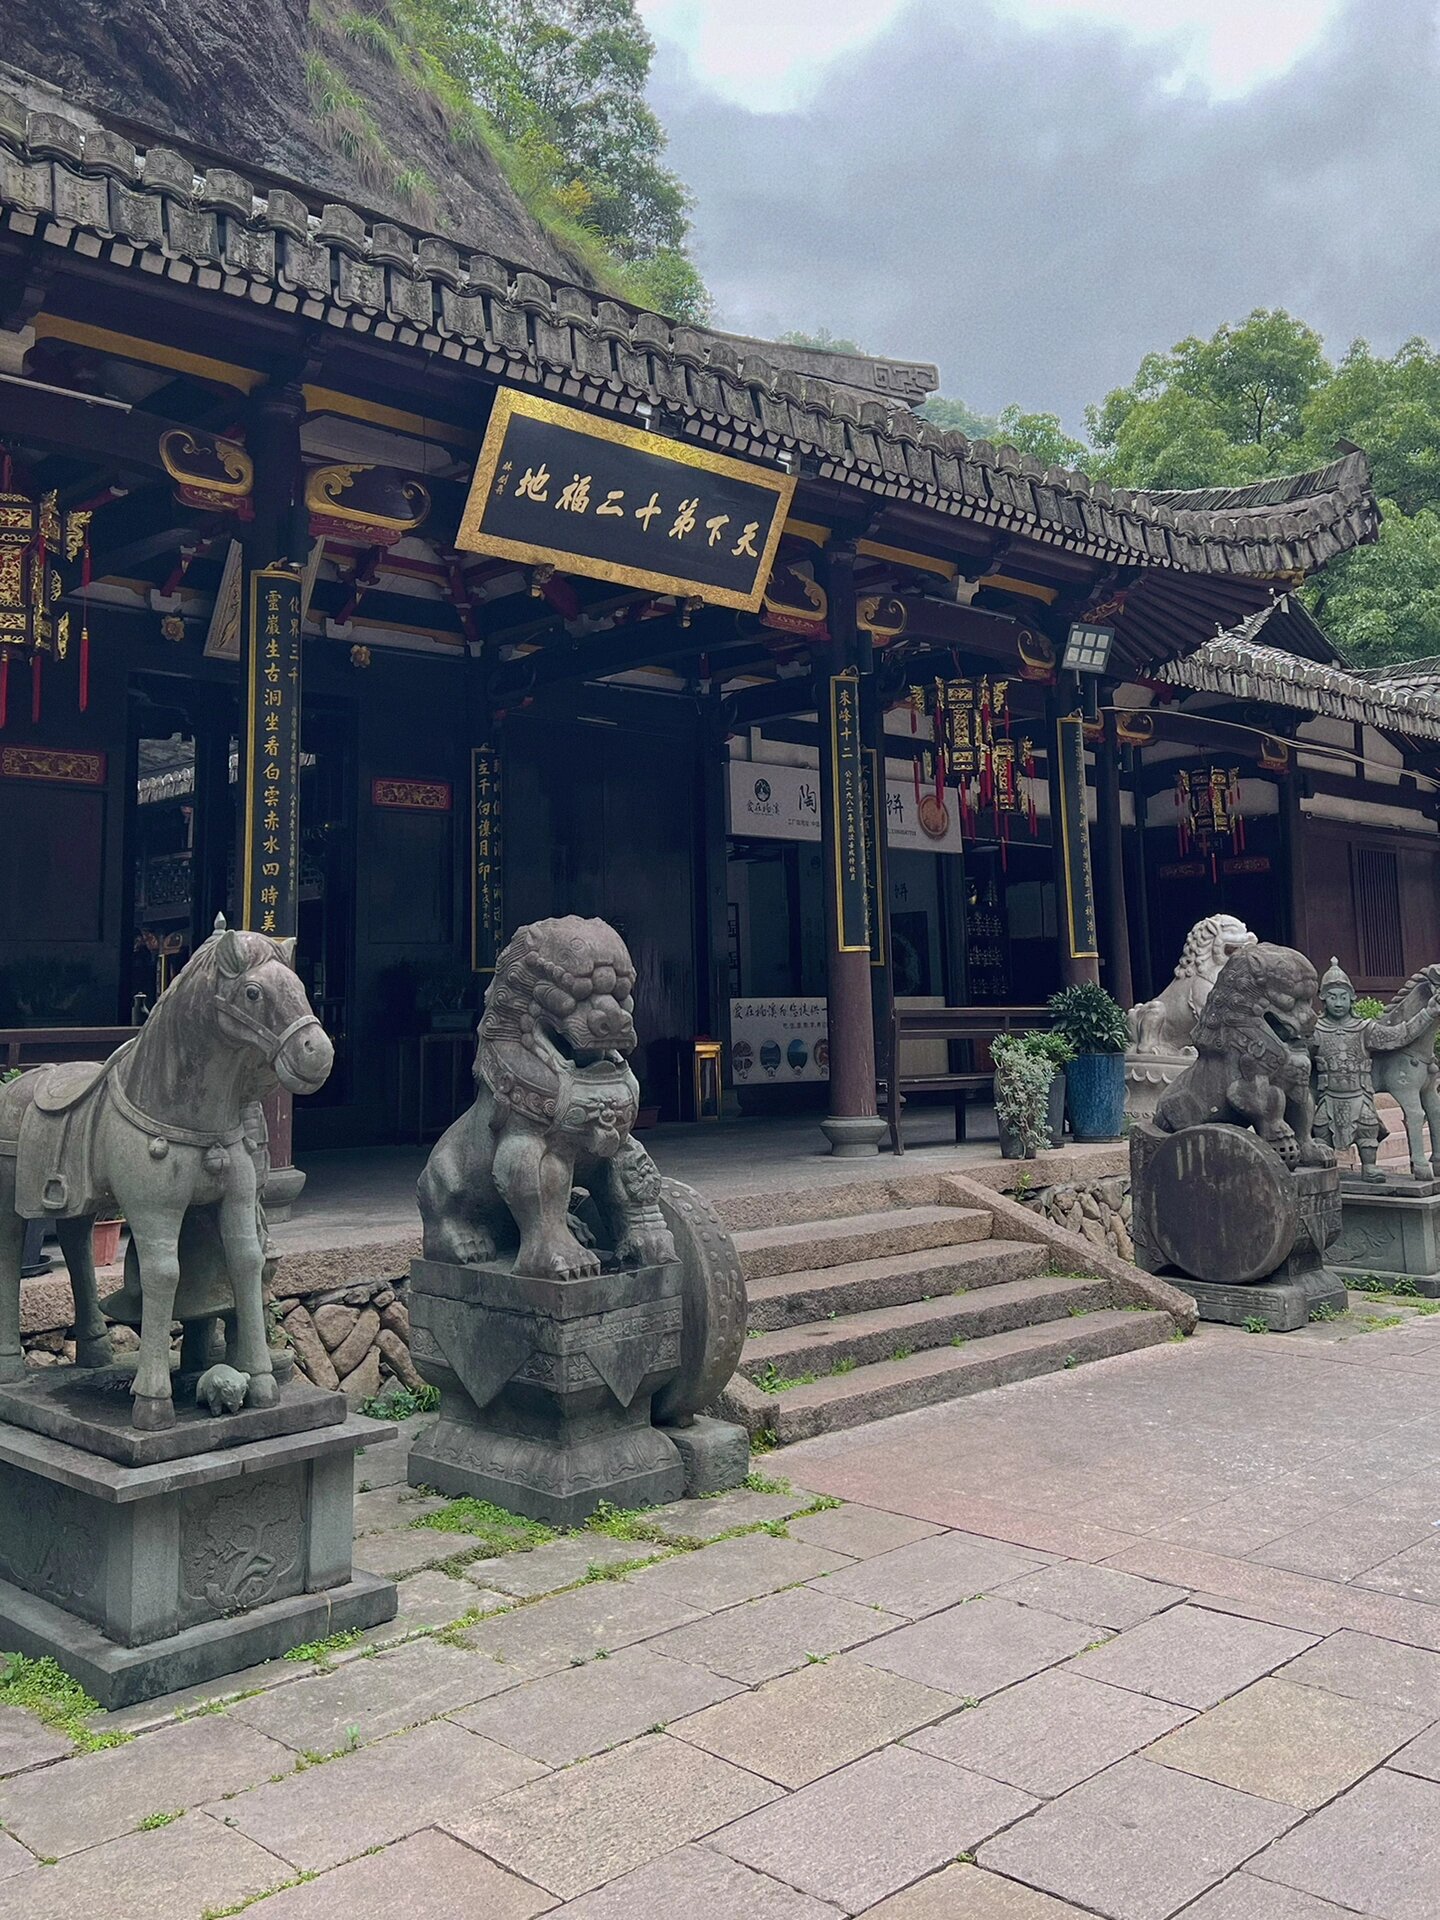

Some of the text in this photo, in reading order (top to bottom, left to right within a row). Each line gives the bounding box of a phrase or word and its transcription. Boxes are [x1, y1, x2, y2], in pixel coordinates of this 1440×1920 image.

[514, 463, 761, 558] 天下第十二福地
[798, 784, 817, 814] 陶
